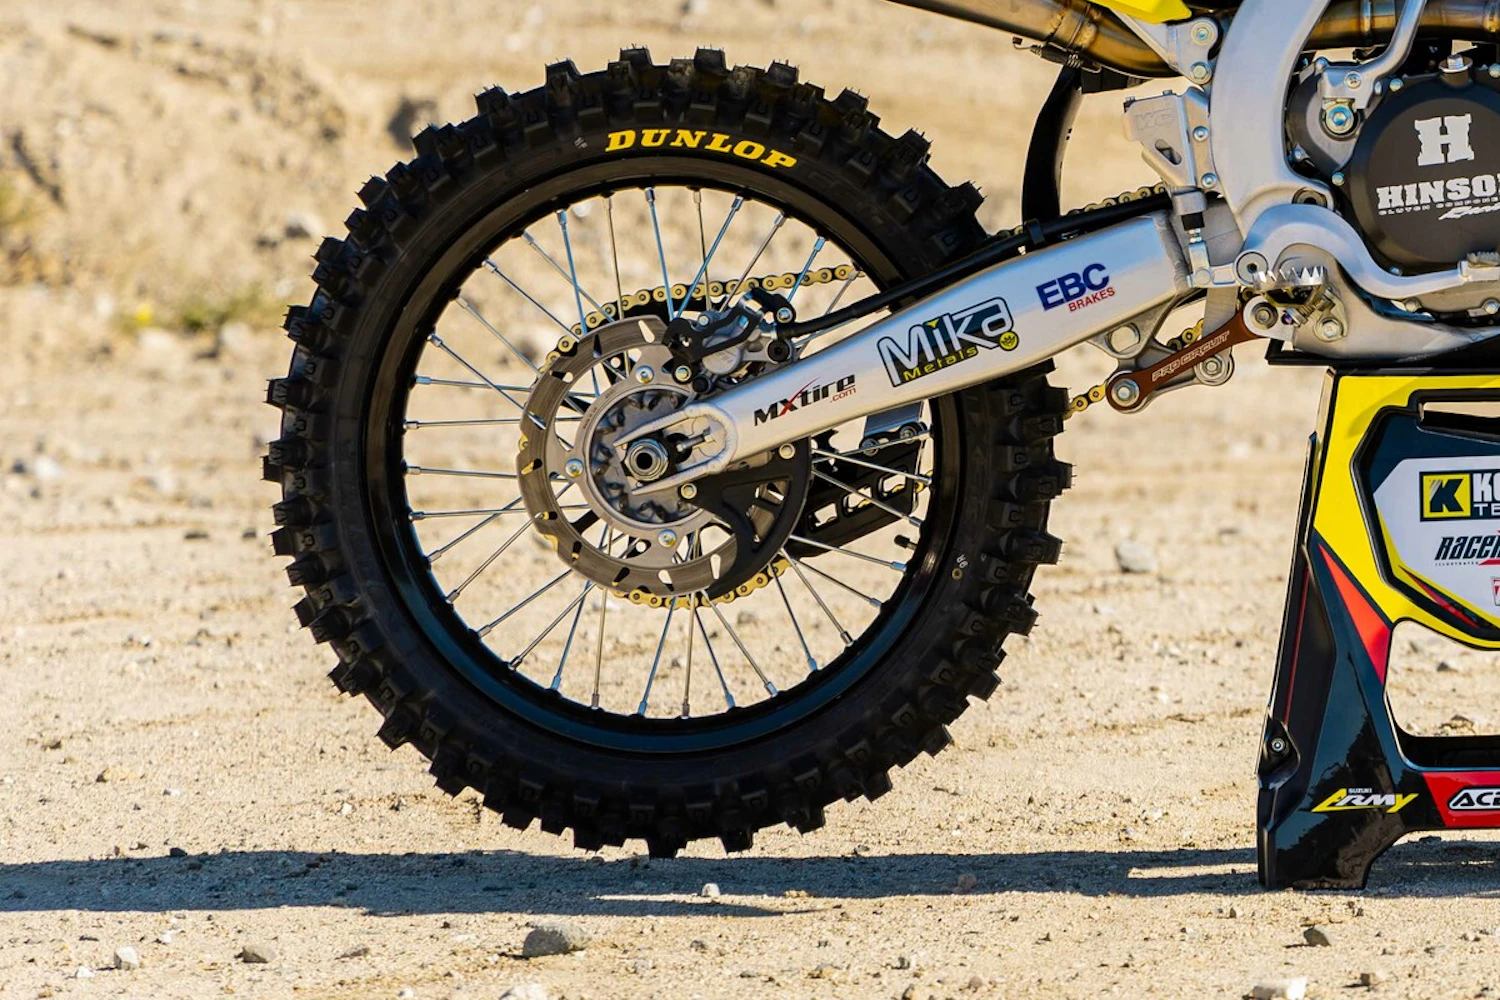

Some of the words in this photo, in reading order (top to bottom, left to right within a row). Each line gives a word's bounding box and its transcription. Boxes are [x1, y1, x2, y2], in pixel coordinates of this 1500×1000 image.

[605, 130, 797, 168] DUNLOP
[1414, 113, 1475, 166] H
[1036, 264, 1110, 311] EBC
[1068, 286, 1116, 313] BRAKES
[903, 345, 977, 382] Metals
[1152, 359, 1181, 382] PRO
[1181, 330, 1230, 366] CIRCUIT
[754, 374, 856, 426] MXtire
[830, 387, 857, 403] .com
